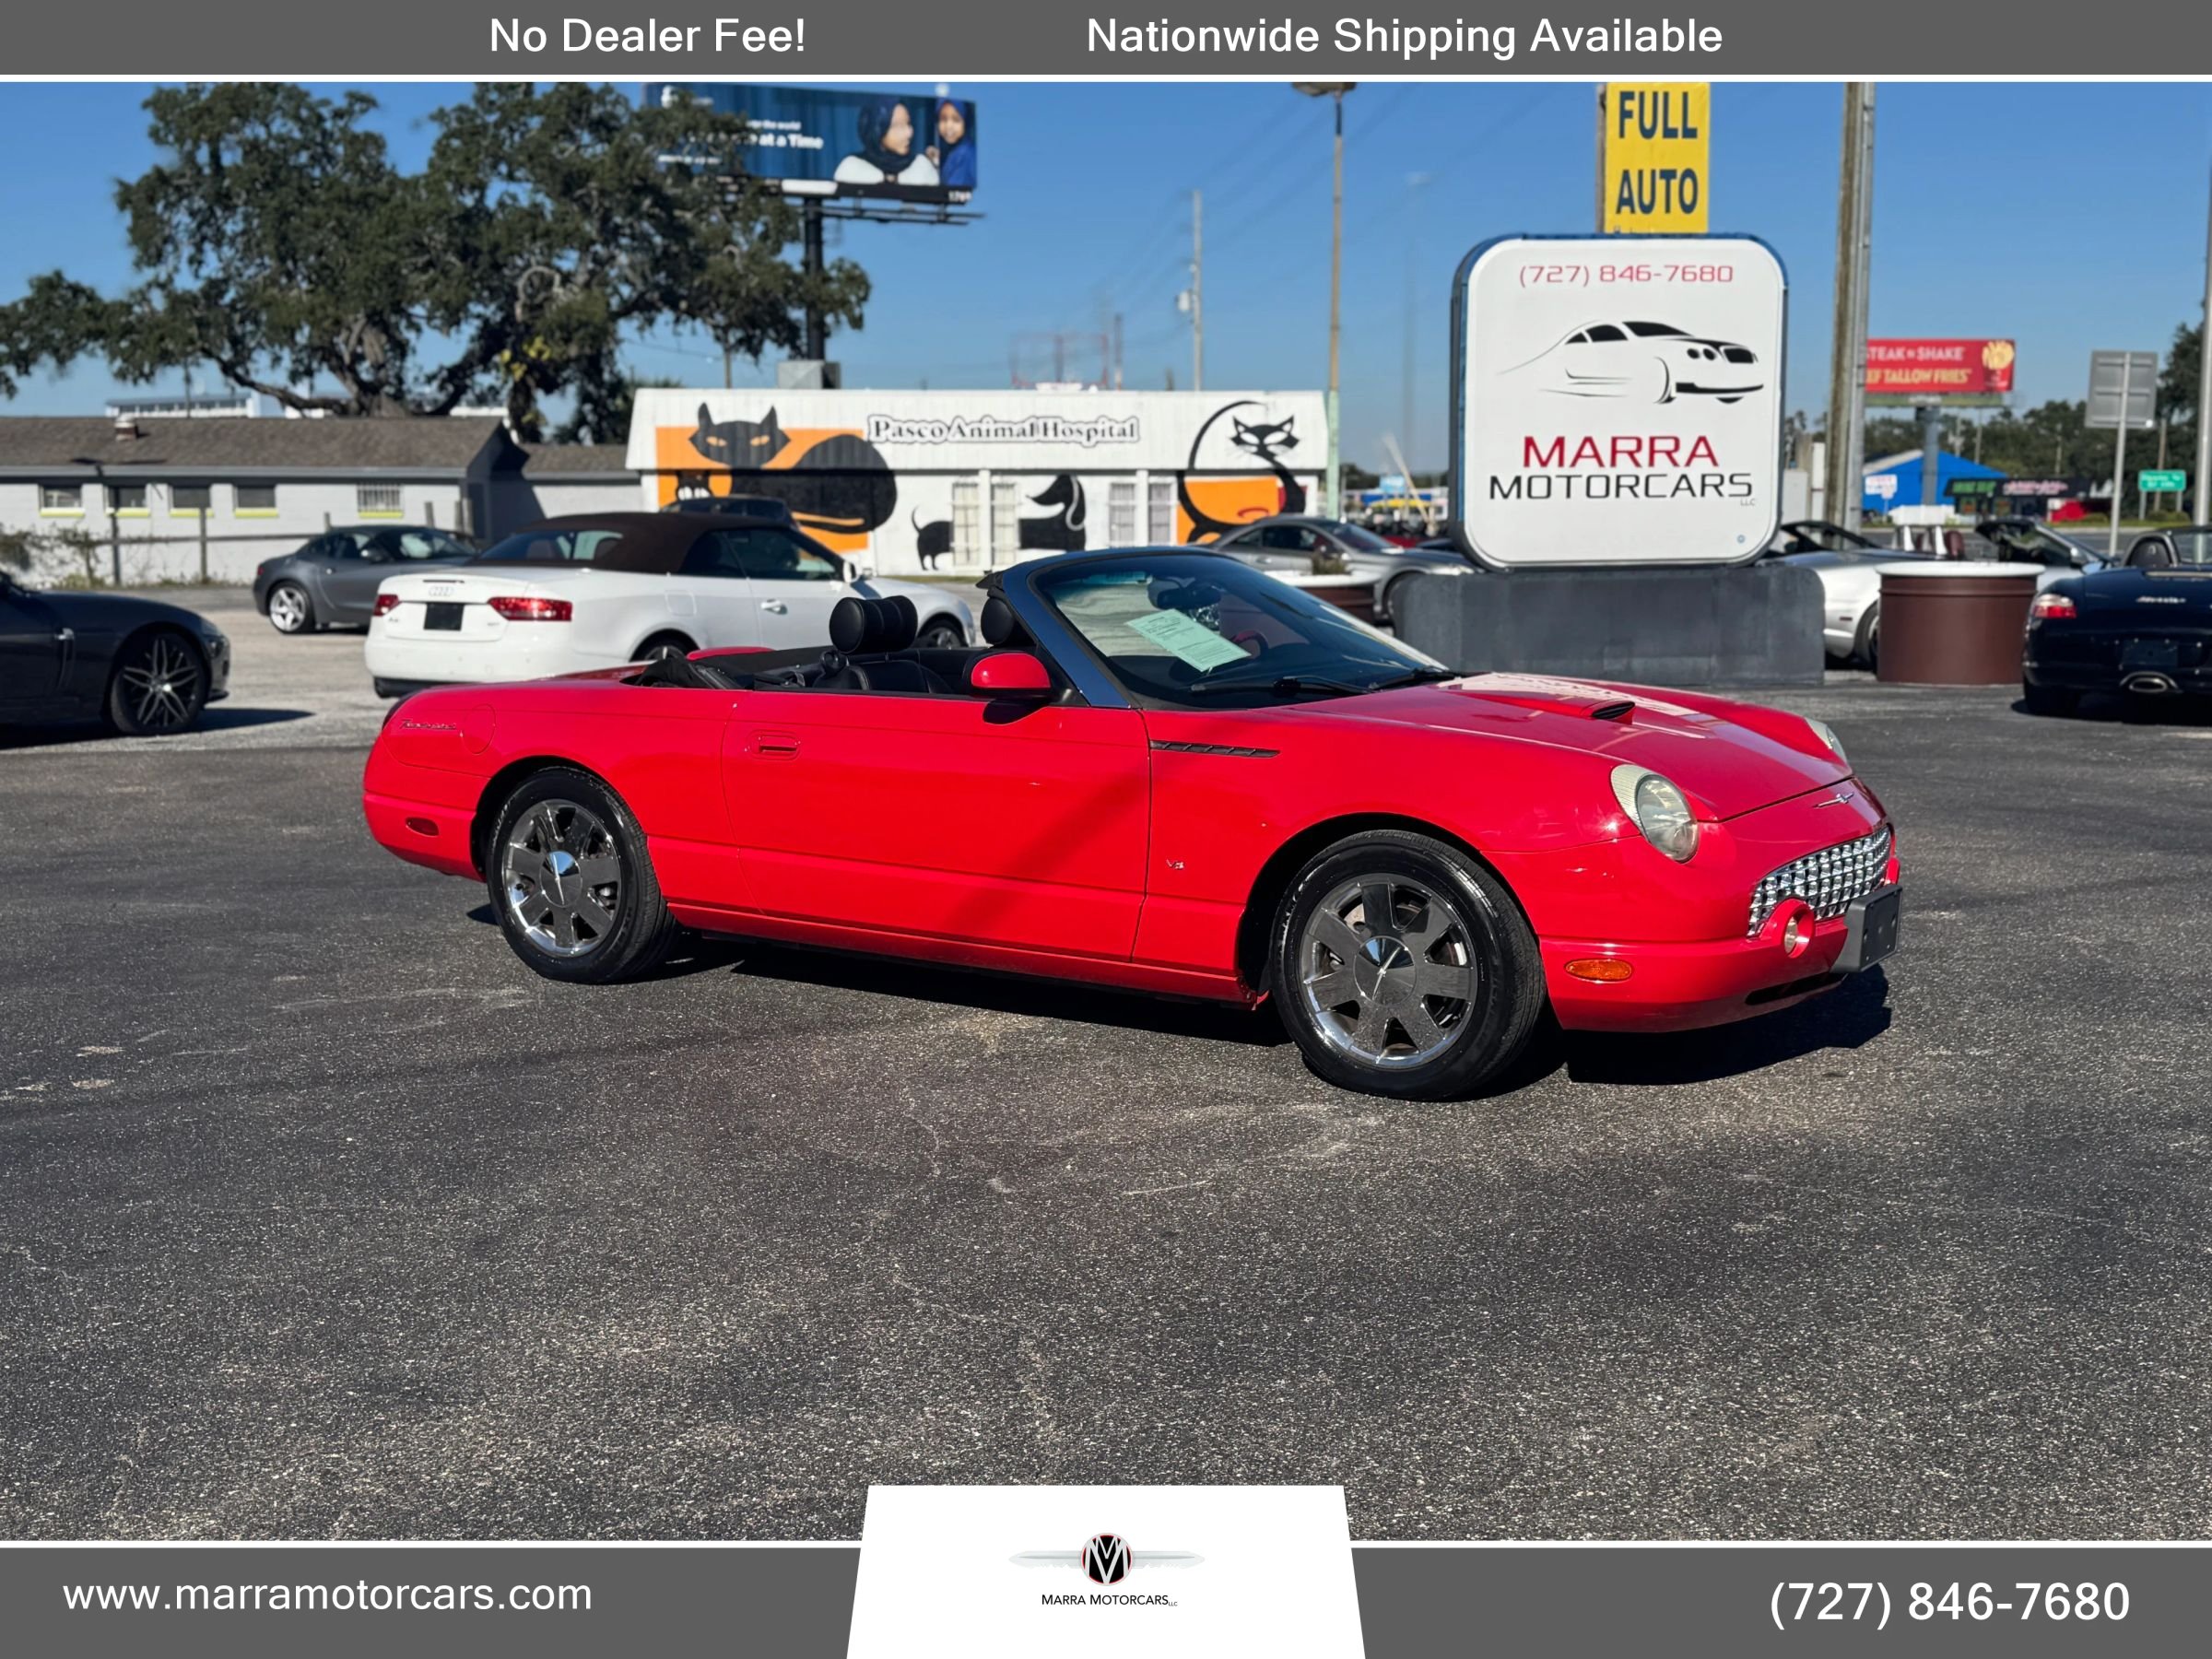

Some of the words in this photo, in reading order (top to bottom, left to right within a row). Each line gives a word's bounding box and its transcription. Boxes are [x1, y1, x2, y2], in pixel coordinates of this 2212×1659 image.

[1618, 91, 1699, 139] FULL
[759, 133, 775, 147] at
[787, 133, 824, 149] Time
[1615, 168, 1699, 215] AUTO
[1519, 265, 1590, 288] (727)
[1599, 264, 1734, 283] 846-7680
[1865, 346, 1906, 361] TEAK
[1916, 346, 1965, 361] SHAKE
[1883, 368, 1933, 384] TALLOW
[874, 418, 946, 440] Pasco
[949, 418, 1036, 440] Animal
[1041, 418, 1135, 442] Hospital
[1523, 435, 1720, 468] MARRA
[1489, 472, 1753, 500] MOTORCARS
